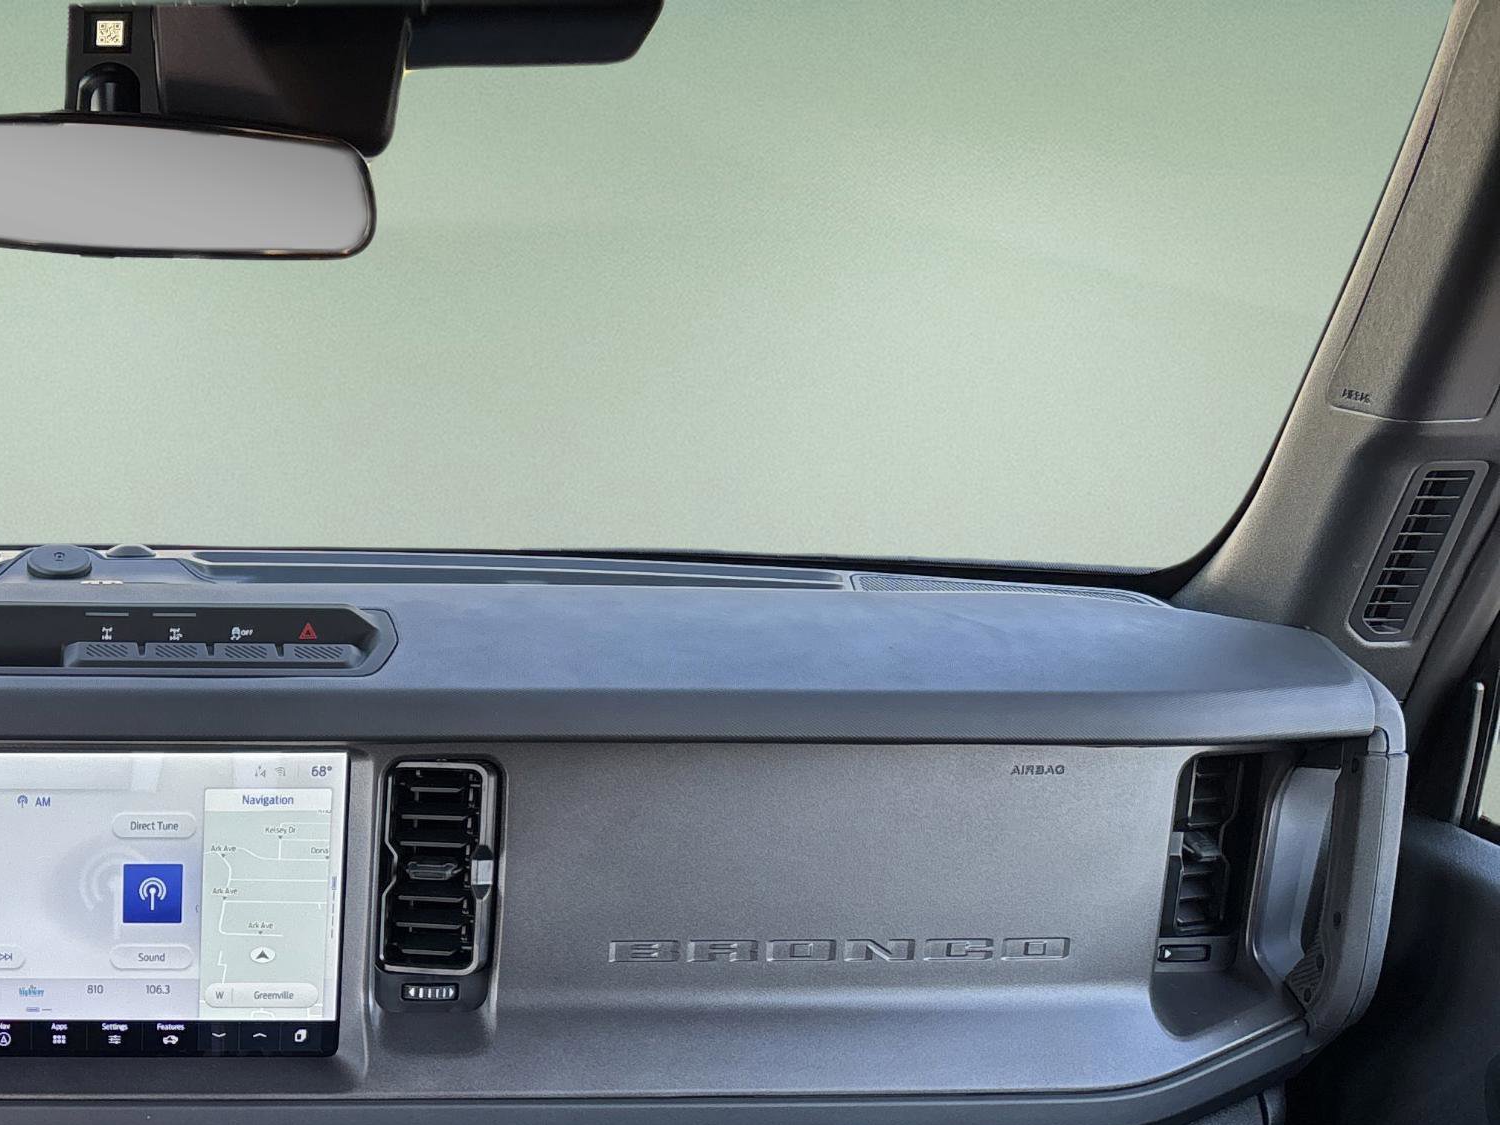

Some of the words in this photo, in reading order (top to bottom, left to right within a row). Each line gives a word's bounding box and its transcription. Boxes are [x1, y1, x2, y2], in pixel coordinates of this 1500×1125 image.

[1010, 764, 1065, 775] AIRBAG
[35, 797, 51, 806] AM
[242, 795, 294, 806] Navigation
[130, 822, 155, 830] Direct
[158, 822, 179, 830] Tune
[607, 936, 1071, 963] BRONCO
[138, 953, 166, 962] Sound
[87, 985, 104, 994] 810
[146, 985, 170, 994] 106.3
[215, 992, 224, 1000] W
[254, 991, 294, 1000] Greenville
[51, 1023, 68, 1031] Apps
[102, 1023, 128, 1031] Settings
